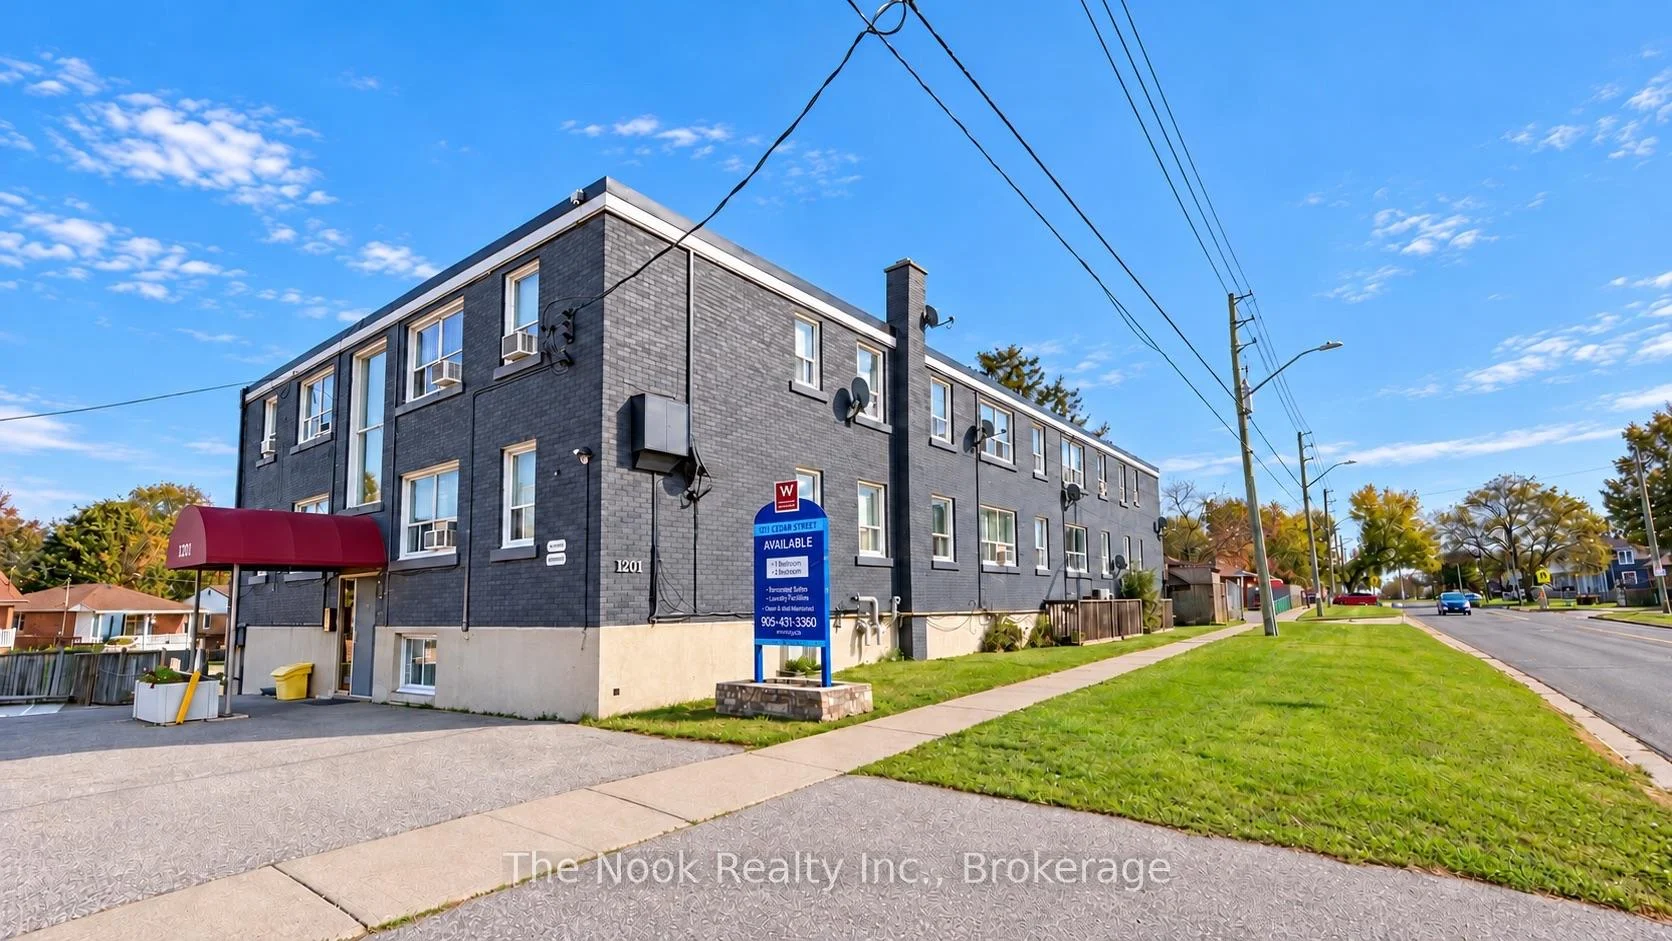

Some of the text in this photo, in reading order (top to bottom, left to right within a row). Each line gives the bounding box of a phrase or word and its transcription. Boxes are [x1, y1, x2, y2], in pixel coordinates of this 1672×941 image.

[779, 484, 794, 497] W
[771, 523, 792, 533] CEDAR
[793, 521, 817, 531] STREET
[764, 536, 813, 551] AVAILABLE
[616, 559, 643, 573] 1201
